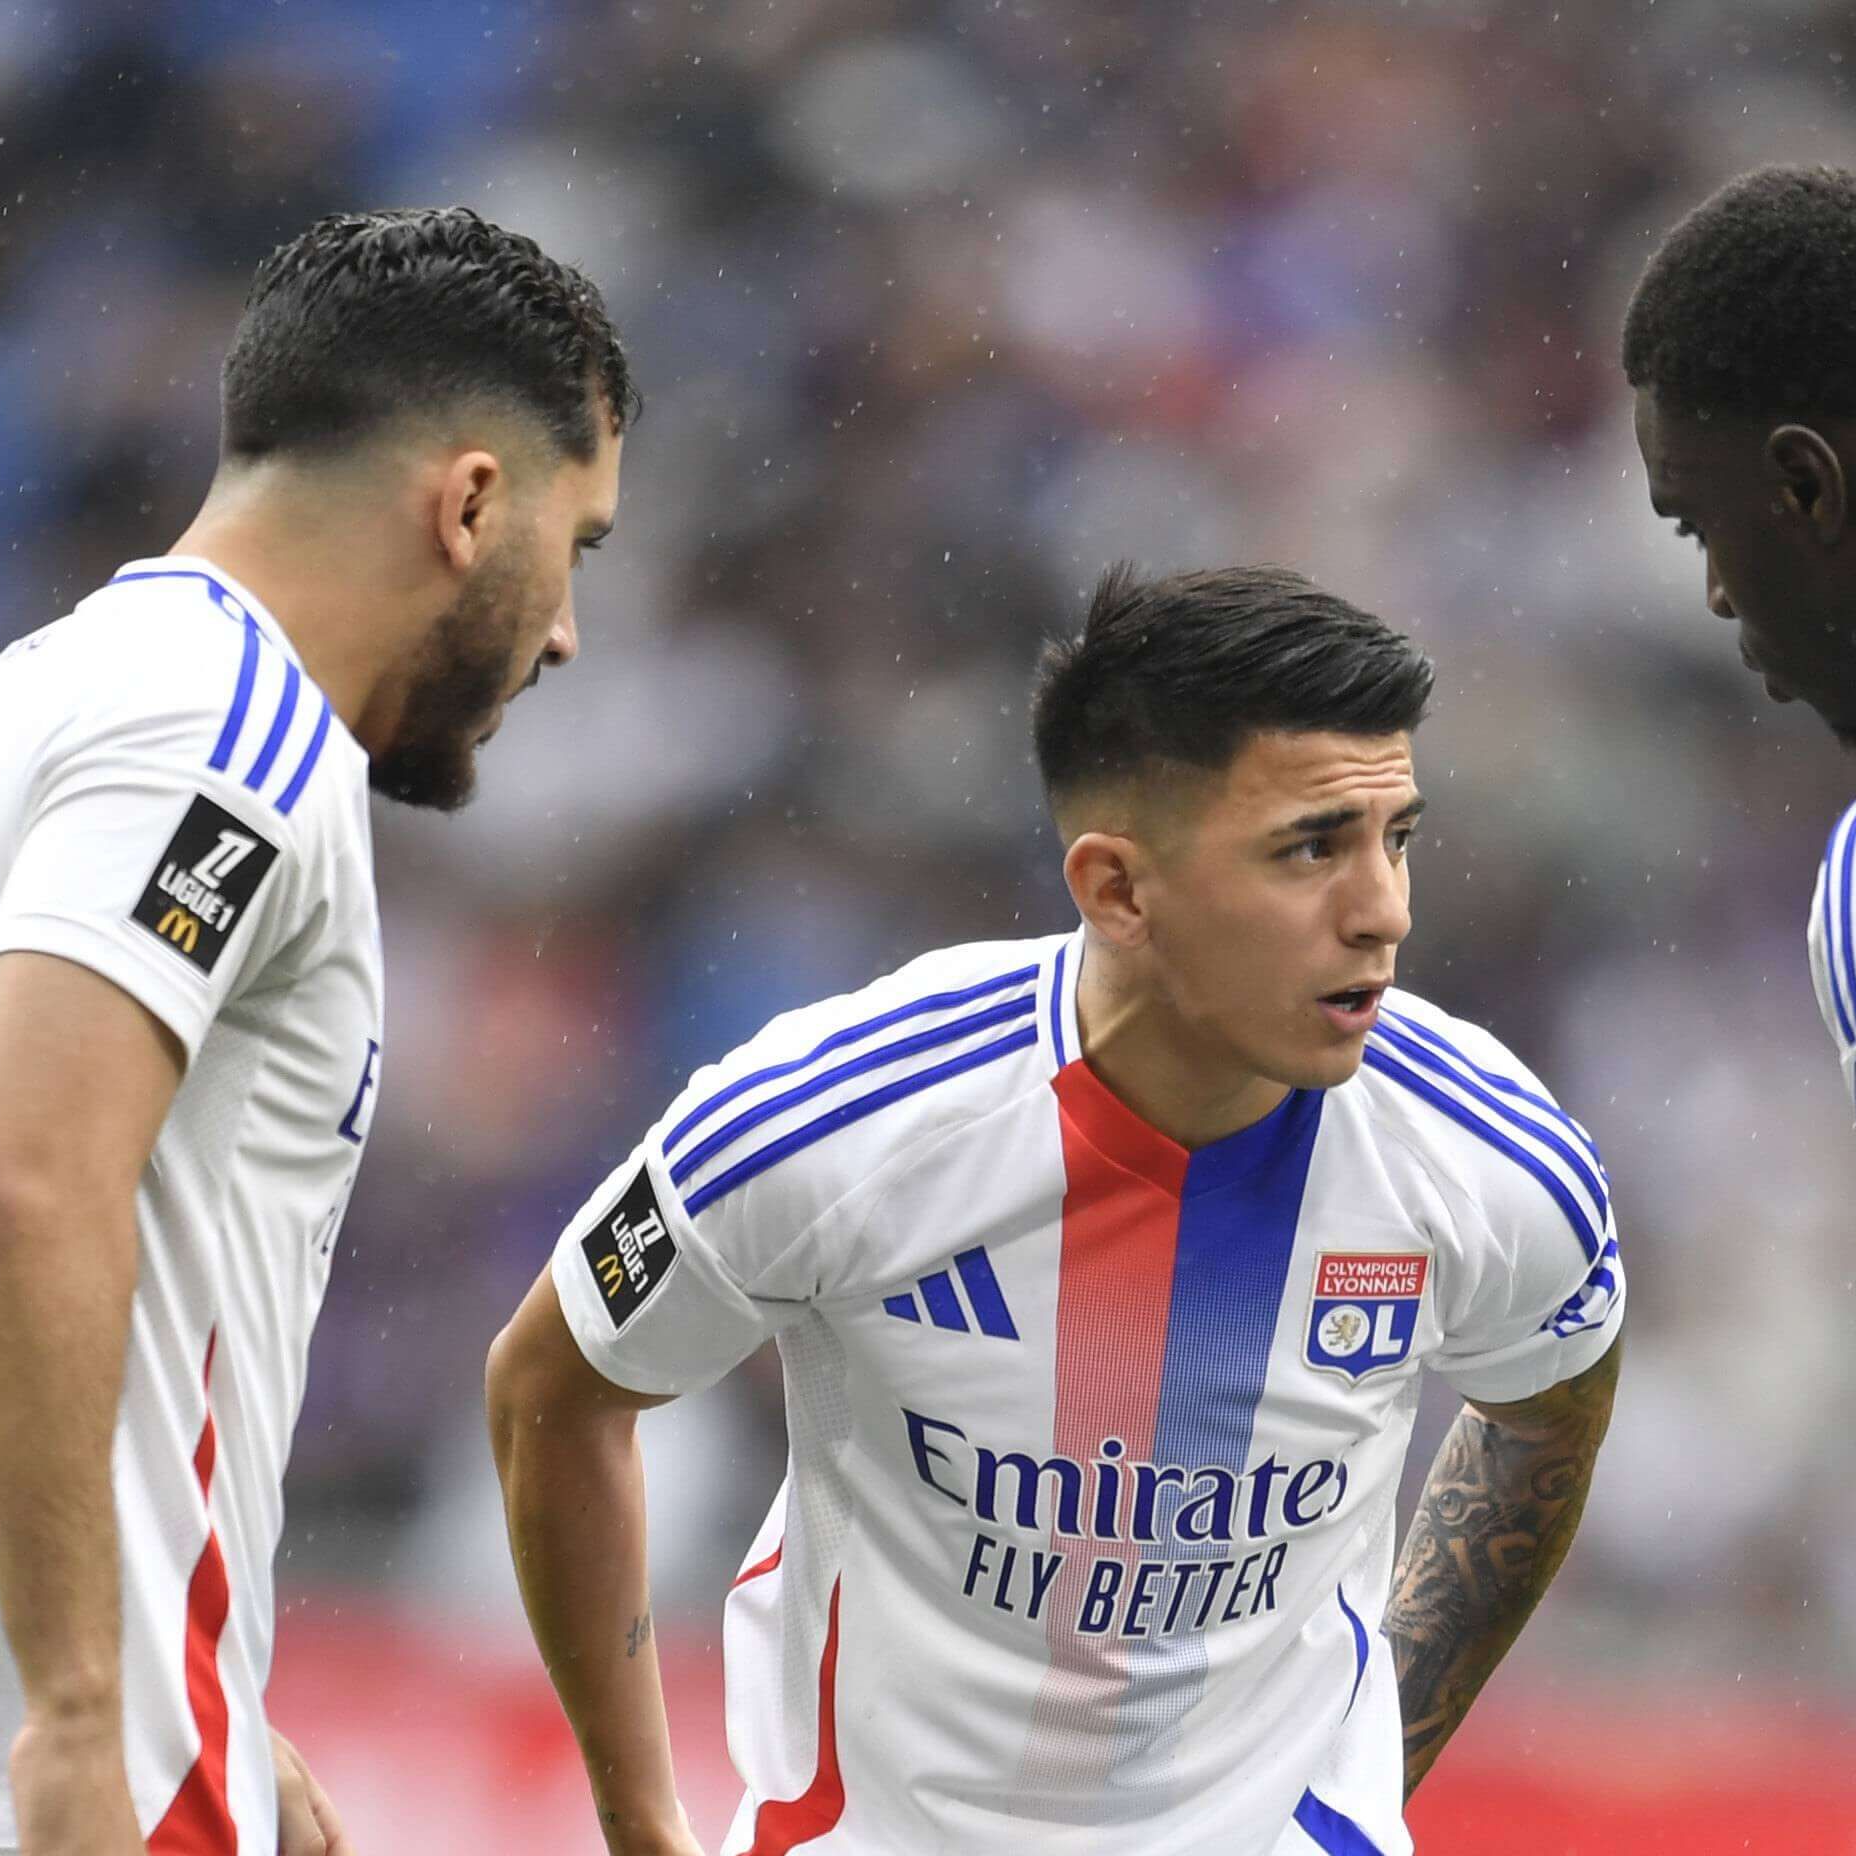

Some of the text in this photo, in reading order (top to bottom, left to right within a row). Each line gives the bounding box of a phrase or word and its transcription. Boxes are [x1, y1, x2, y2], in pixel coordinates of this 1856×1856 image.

[157, 861, 225, 924] LIGUE
[610, 1212, 645, 1283] LIGUE
[1325, 1262, 1420, 1277] OLYMPIQUE
[1323, 1277, 1418, 1294] LYONNAIS
[963, 1535, 1288, 1638] FLY BETTER
